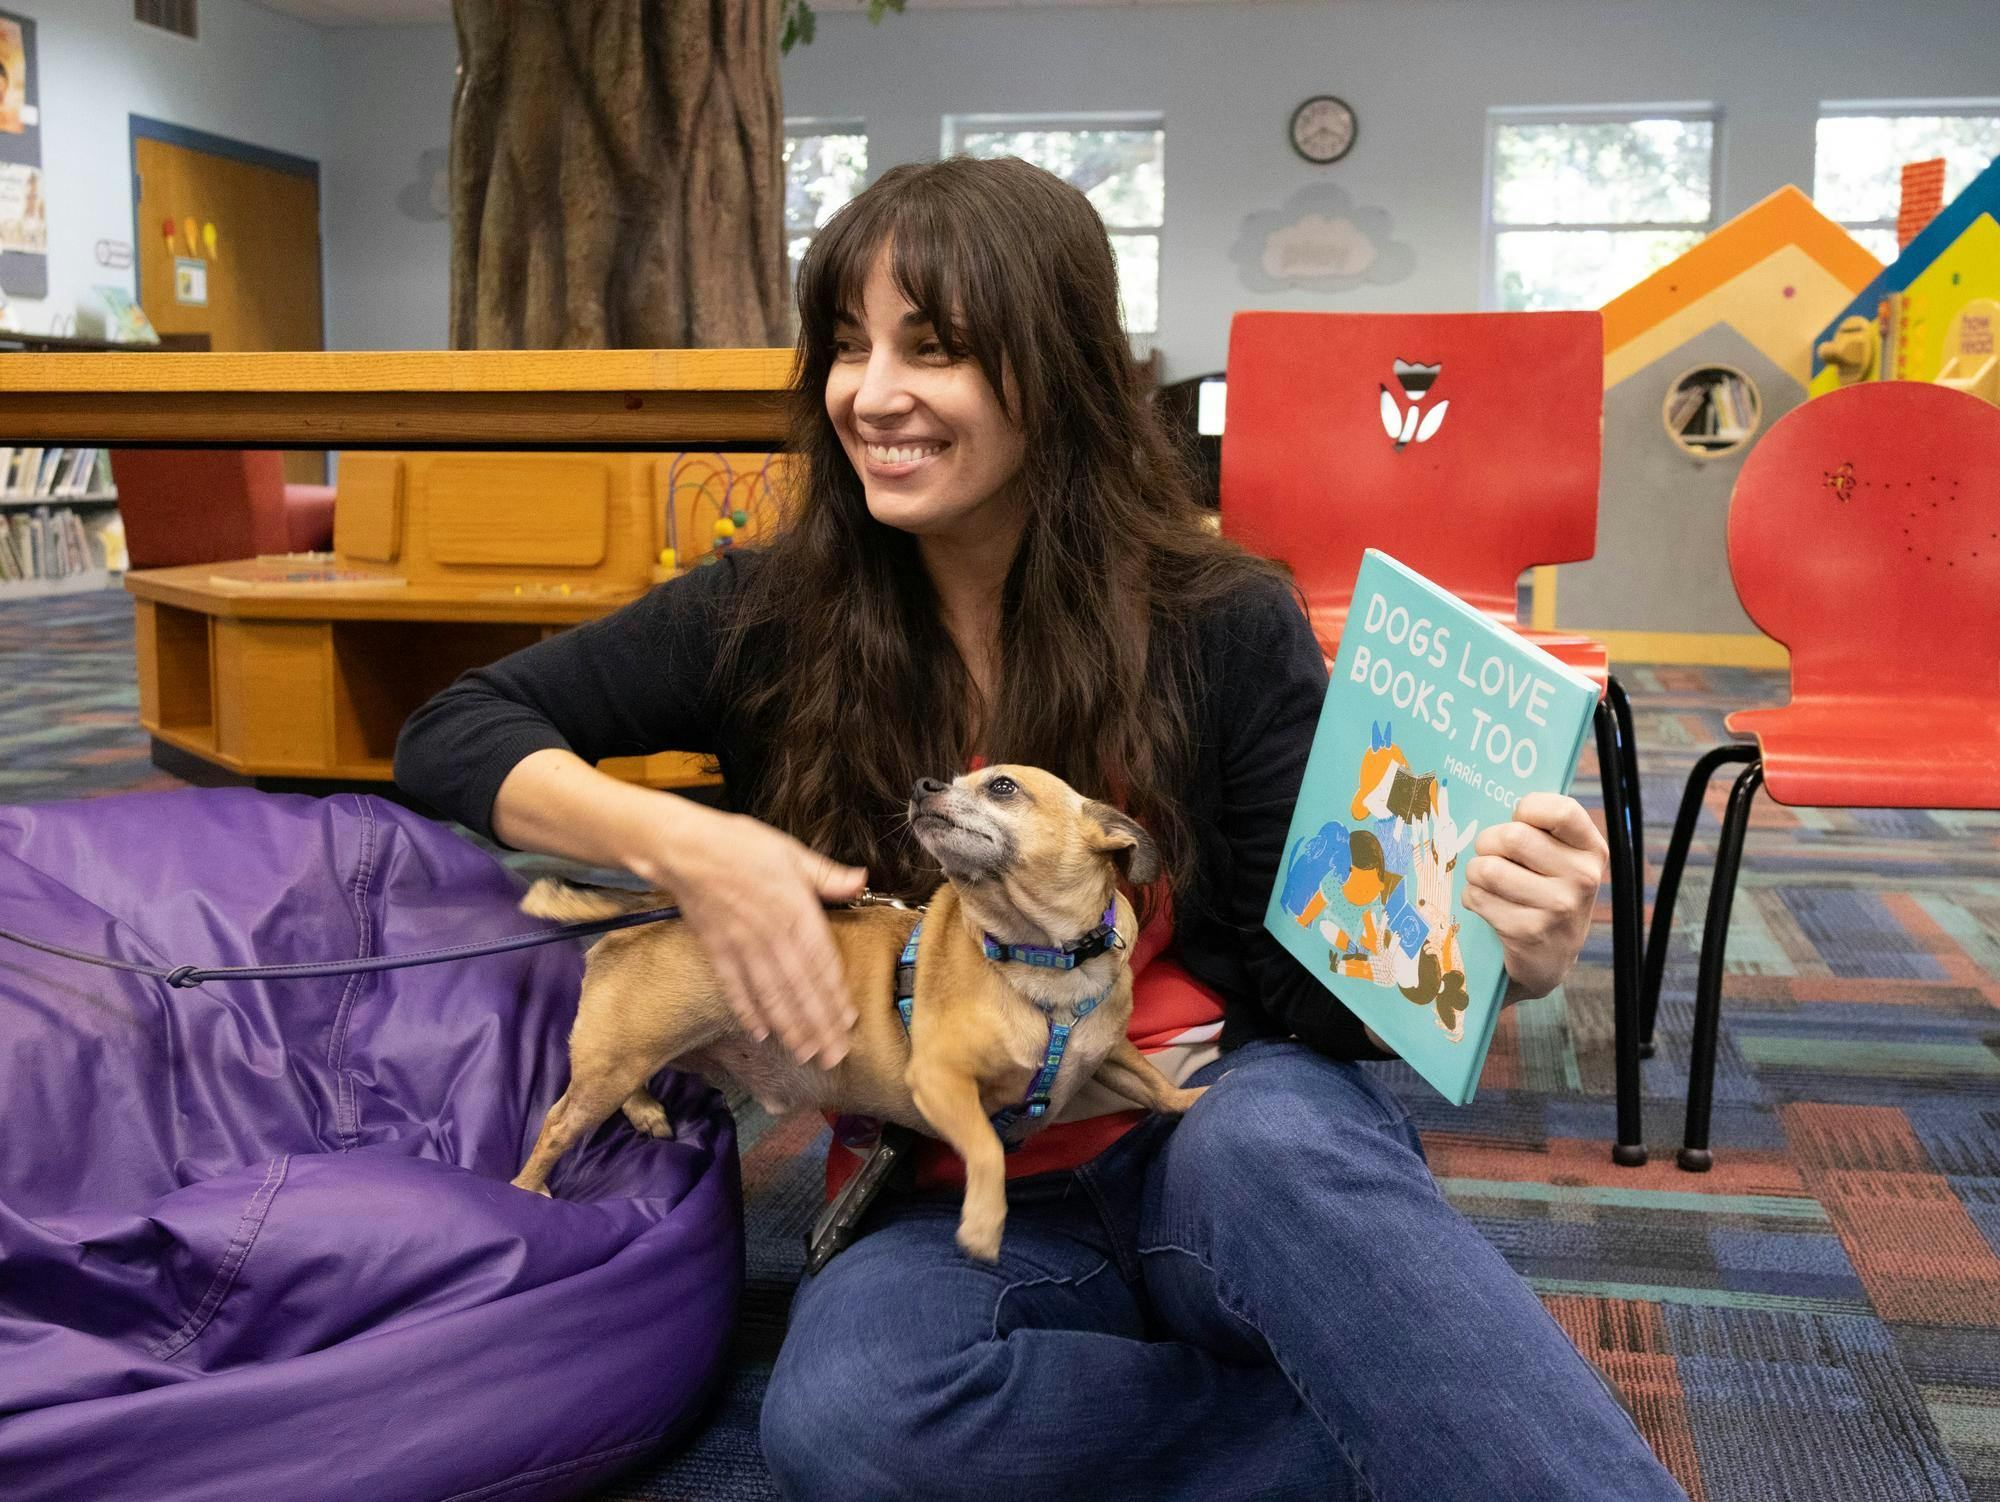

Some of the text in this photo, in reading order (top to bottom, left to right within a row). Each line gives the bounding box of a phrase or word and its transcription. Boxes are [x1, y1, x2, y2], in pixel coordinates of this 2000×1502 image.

[1350, 645, 1538, 779] BOOKS, TOO
[1364, 593, 1556, 727] DOGS LOVE
